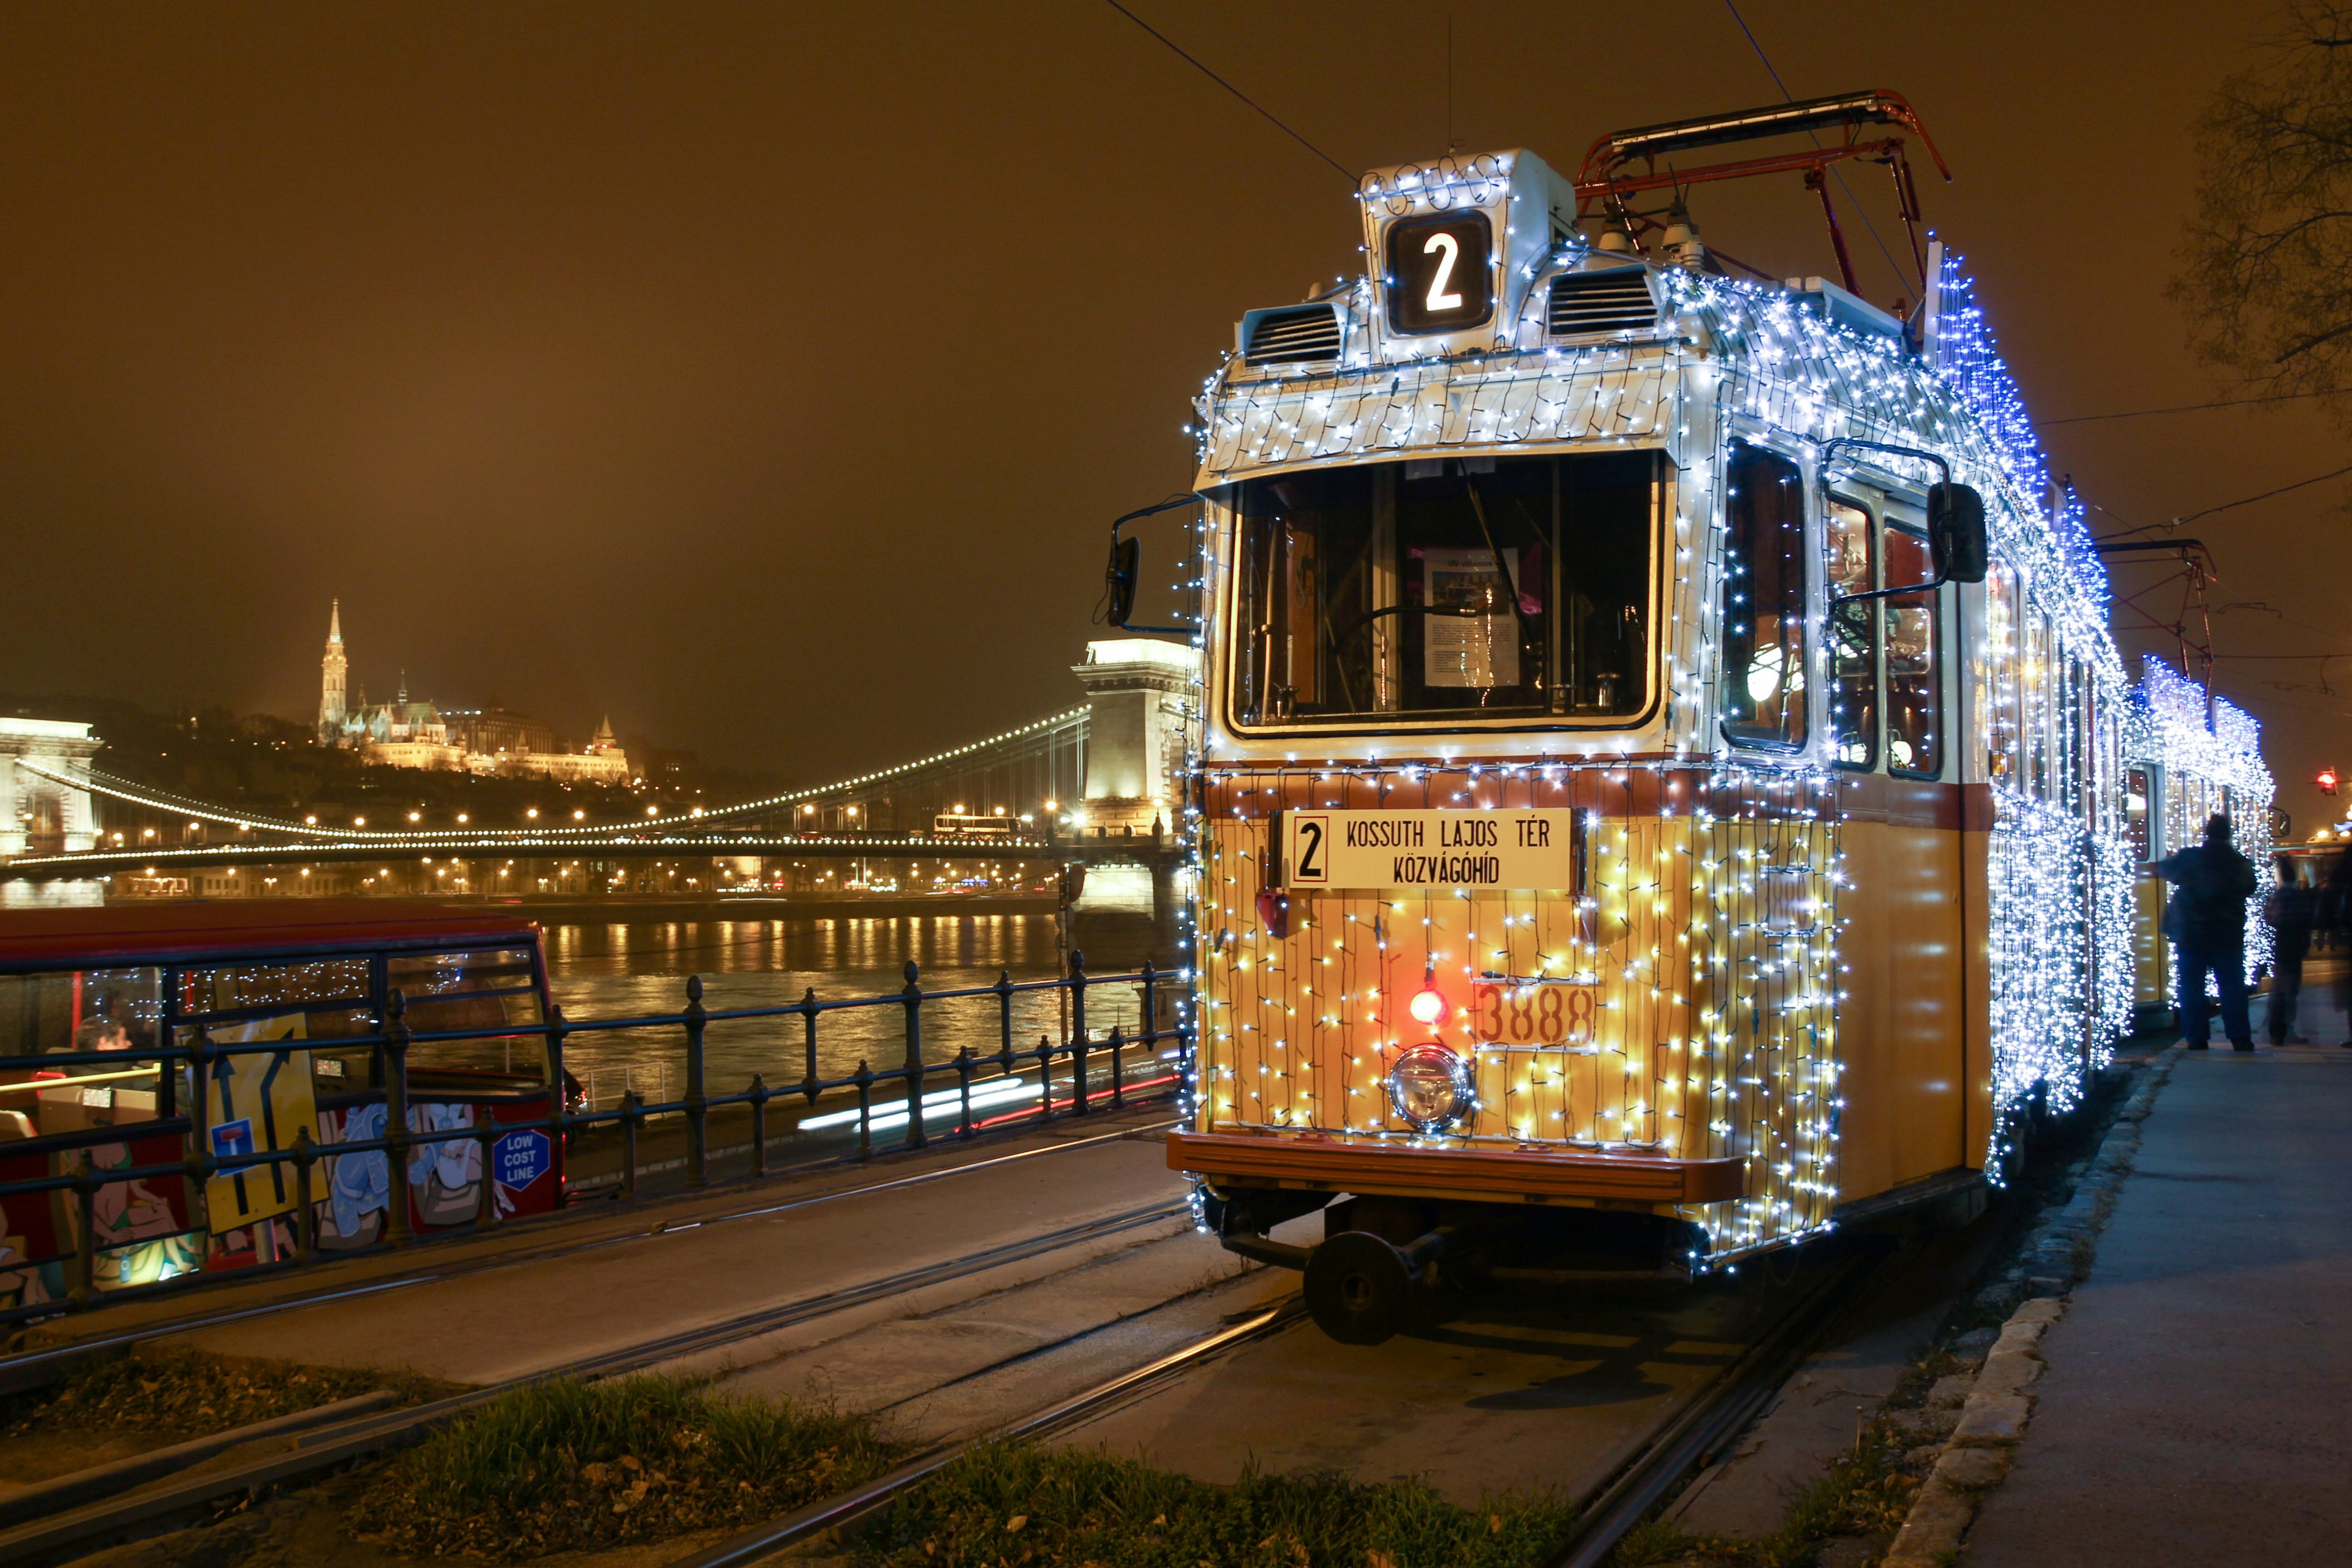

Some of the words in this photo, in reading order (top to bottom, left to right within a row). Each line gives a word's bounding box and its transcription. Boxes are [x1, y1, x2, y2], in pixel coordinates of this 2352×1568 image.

[1423, 232, 1462, 312] 2
[1347, 820, 1423, 848] KOSSUTH
[1441, 820, 1498, 848] LAJOS
[1516, 815, 1550, 848] TÉR
[1298, 821, 1322, 877] 2
[1394, 851, 1500, 884] KÖZVÁGÓHÍD
[1479, 985, 1593, 1044] 3888
[503, 1150, 536, 1167] COST
[507, 1135, 533, 1151] LOW
[507, 1166, 534, 1182] LINE
